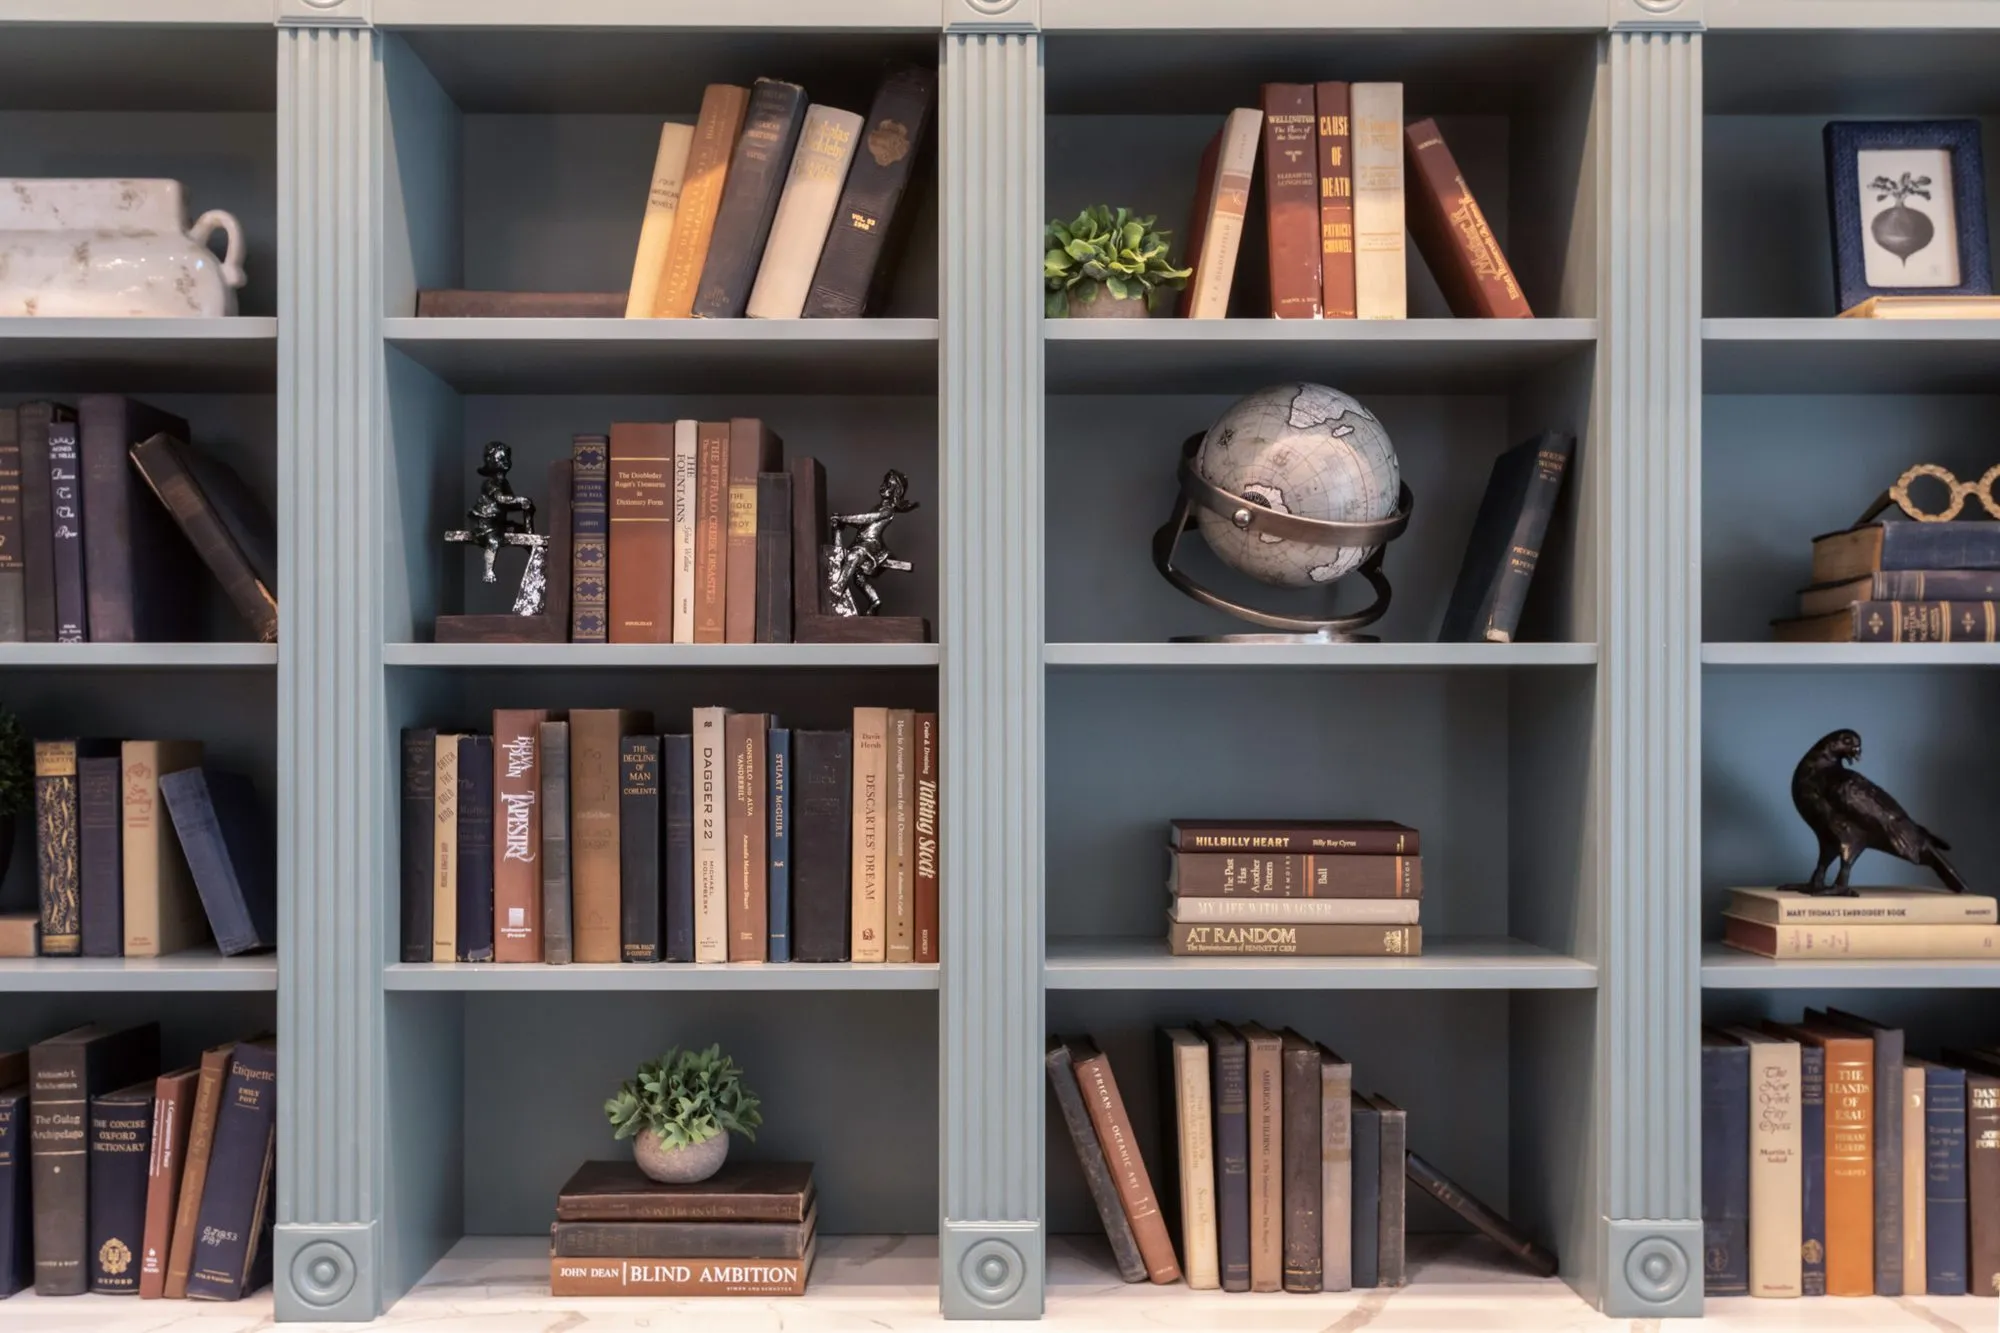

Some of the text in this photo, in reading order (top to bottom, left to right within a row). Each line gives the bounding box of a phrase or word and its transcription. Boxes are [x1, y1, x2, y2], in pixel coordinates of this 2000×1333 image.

[1320, 116, 1348, 136] CAUSE
[1331, 146, 1343, 166] OF
[1322, 177, 1350, 197] DEATH
[686, 455, 696, 478] THE
[631, 472, 662, 480] Doubleday
[615, 481, 636, 489] Roget's
[676, 453, 686, 523] FOUNTAINS
[616, 499, 646, 507] Dictionary
[706, 438, 719, 604] THE BUFFALO CREEK DISASTER
[517, 735, 535, 771] BELVA
[633, 745, 648, 753] THE
[501, 740, 522, 778] PLAIN
[623, 754, 656, 762] DECLINE
[635, 763, 645, 772] OF
[776, 753, 784, 793] STUART
[630, 772, 651, 781] MAN
[623, 787, 657, 796] COBLENTZ
[703, 747, 713, 840] DAGGER 22
[917, 780, 936, 879] Taking Stock
[865, 774, 875, 904] DESCARTES' DREAM
[1196, 836, 1290, 847] HILLBILLY HEART
[1312, 839, 1357, 848] Billy Ray Cyrus
[1225, 858, 1234, 893] The Past
[1238, 867, 1246, 884] Has
[1251, 859, 1261, 893] Another
[1264, 861, 1274, 890] Pattern
[1317, 868, 1328, 884] Ball
[1198, 902, 1214, 915] MY
[1220, 902, 1245, 914] LIFE
[1248, 903, 1278, 914] WITH
[1786, 909, 1806, 917] MARY
[1842, 909, 1886, 917] EMBROIDERY
[1886, 909, 1907, 917] BOOK
[1187, 928, 1296, 944] AT RANDOM
[1187, 944, 1198, 952] The
[232, 1060, 276, 1082] Etiquette
[1763, 1065, 1787, 1079] The
[1837, 1069, 1864, 1081] THE
[238, 1087, 260, 1097] EMILY
[1759, 1078, 1789, 1092] New
[1829, 1083, 1870, 1094] HANDS
[1759, 1092, 1792, 1106] York
[1842, 1096, 1860, 1107] OF
[1263, 1069, 1271, 1156] AMERICAN BUILDING
[1762, 1107, 1788, 1121] City
[1835, 1109, 1866, 1121] ESAU
[35, 1114, 81, 1126] The Gulag
[93, 1119, 146, 1129] THE CONCISE
[1759, 1119, 1791, 1135] Opera
[1092, 1067, 1140, 1189] AFRICAN OCEANIC ART
[99, 1131, 136, 1140] OXFORD
[93, 1142, 145, 1153] DICTIONARY
[1759, 1148, 1794, 1156] Martin L.
[560, 1266, 798, 1284] JOHN DEAN BLIND AMBITION
